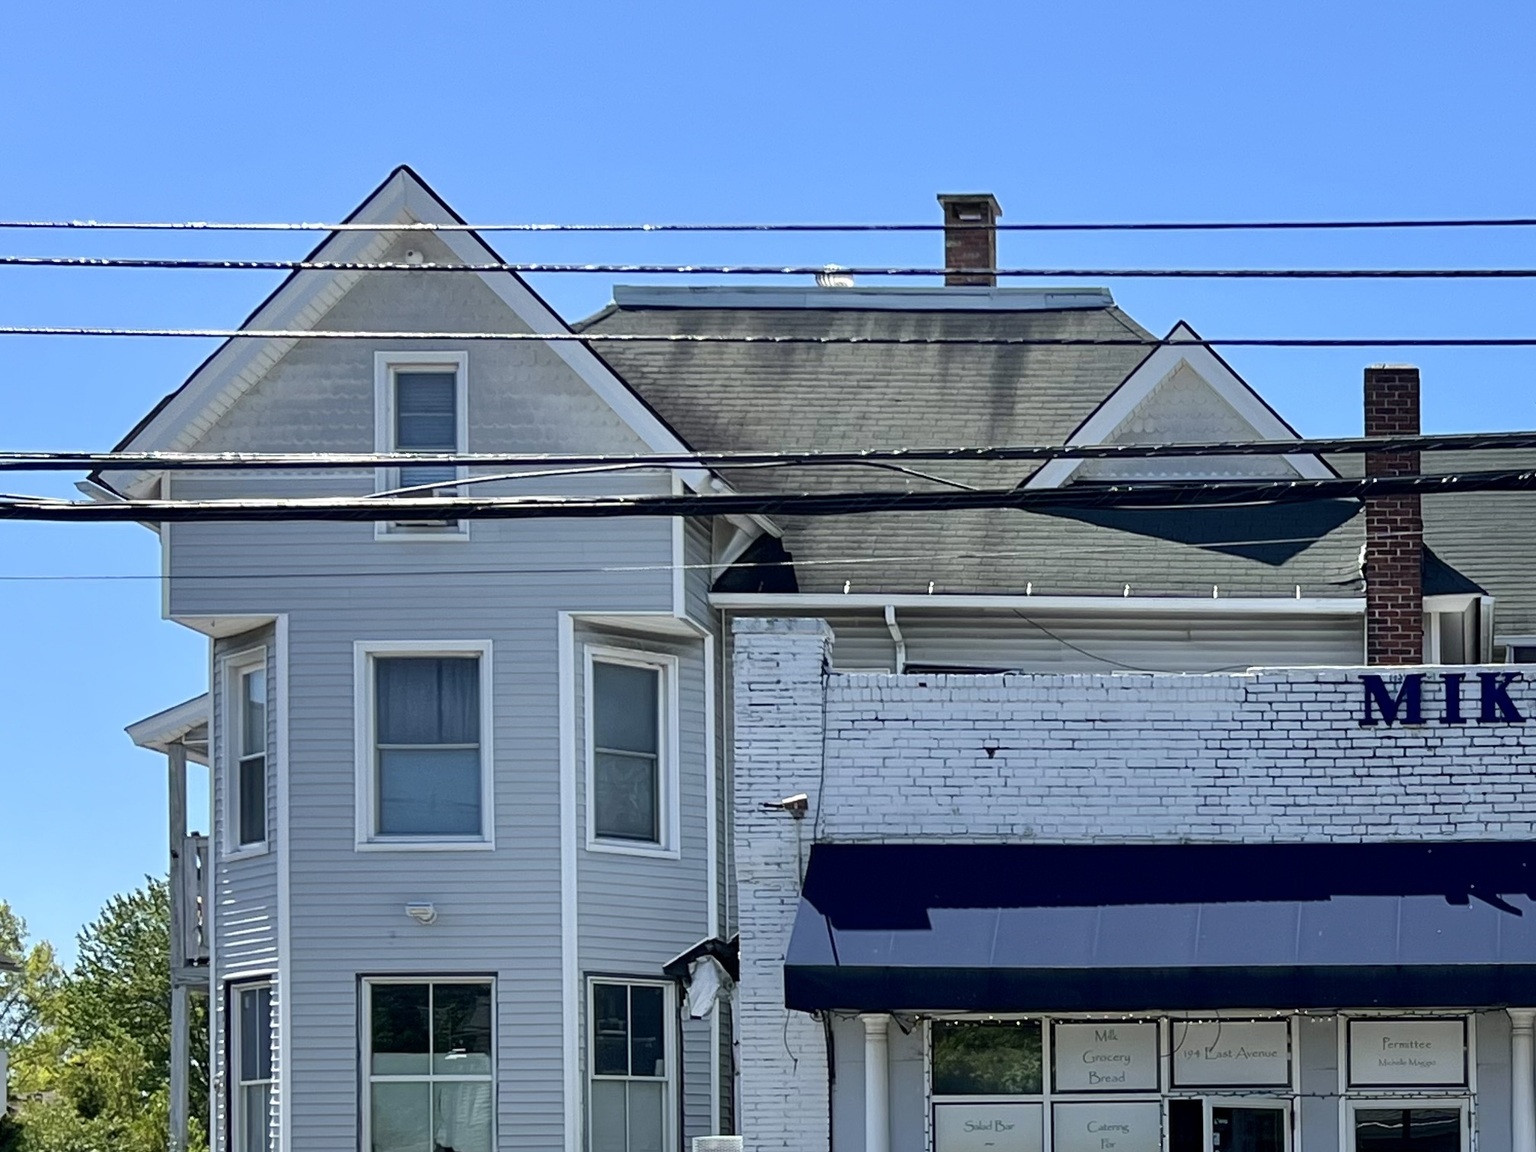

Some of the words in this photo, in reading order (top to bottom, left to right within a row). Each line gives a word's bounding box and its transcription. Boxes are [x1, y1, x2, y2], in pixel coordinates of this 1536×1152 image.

[1094, 1029, 1119, 1042] Milk
[1382, 1036, 1432, 1051] Permittee
[1082, 1050, 1131, 1065] Grocery
[1183, 1049, 1200, 1060] 194
[1236, 1046, 1278, 1060] Avenue
[1088, 1070, 1126, 1085] Bread
[963, 1119, 993, 1133] Salad
[995, 1119, 1016, 1133] Bar
[1086, 1120, 1130, 1134] Catering
[1101, 1137, 1117, 1150] For
